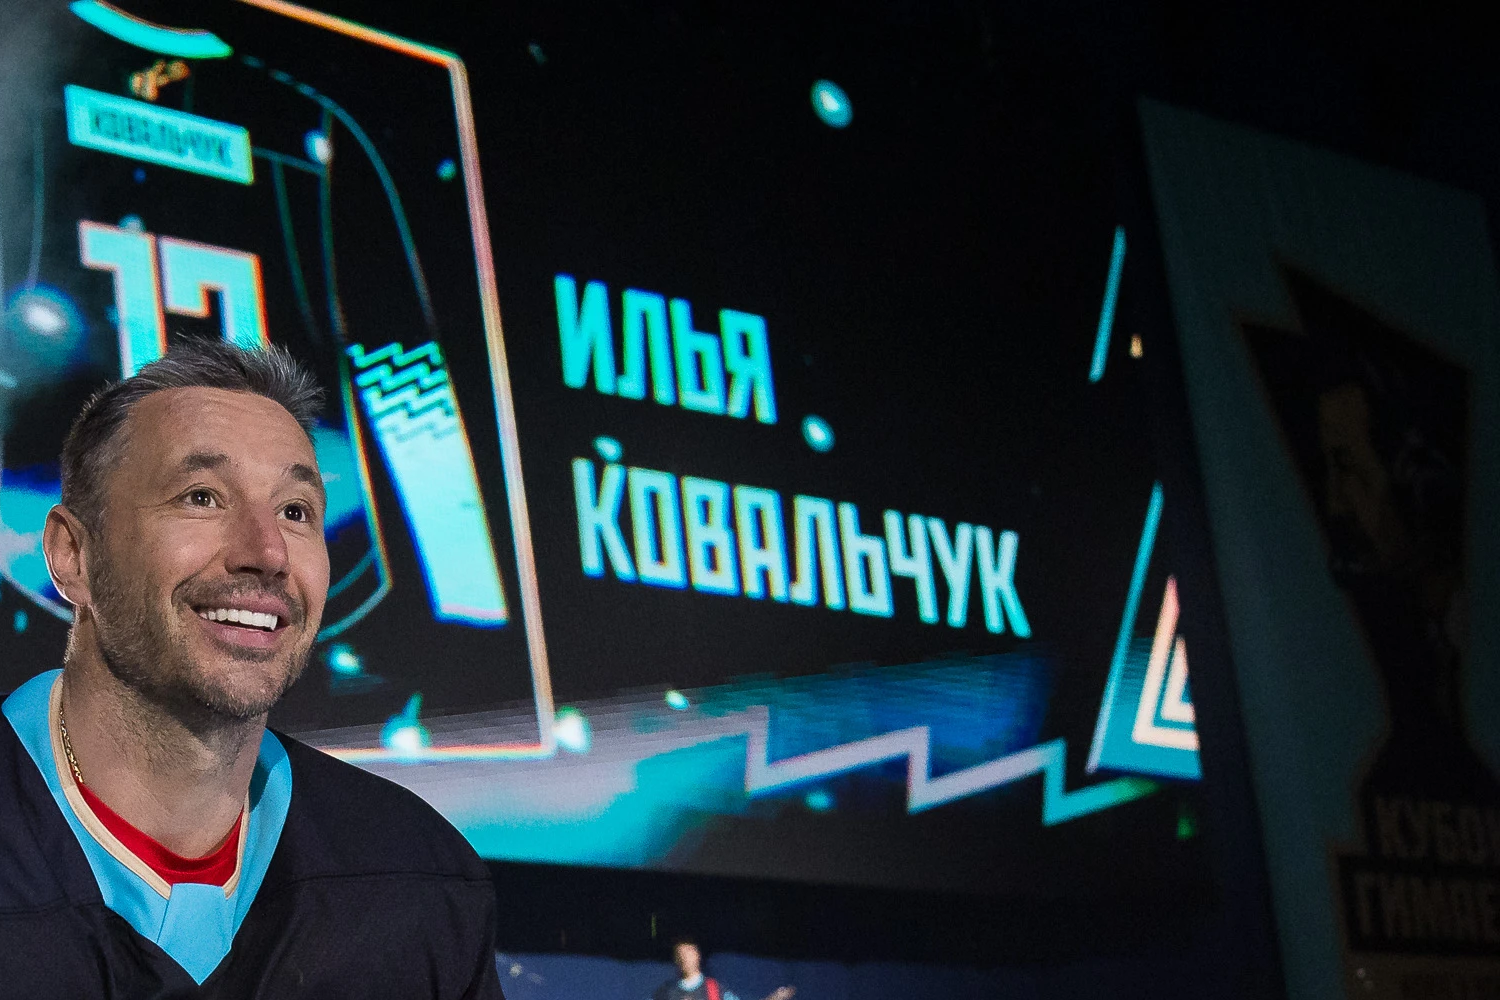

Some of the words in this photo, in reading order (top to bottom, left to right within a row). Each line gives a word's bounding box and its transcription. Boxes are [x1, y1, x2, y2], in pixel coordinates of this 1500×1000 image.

[78, 219, 270, 381] 17
[554, 273, 778, 425] ИЛЬЯ
[572, 456, 1032, 638] КОВАЛЬЧУК
